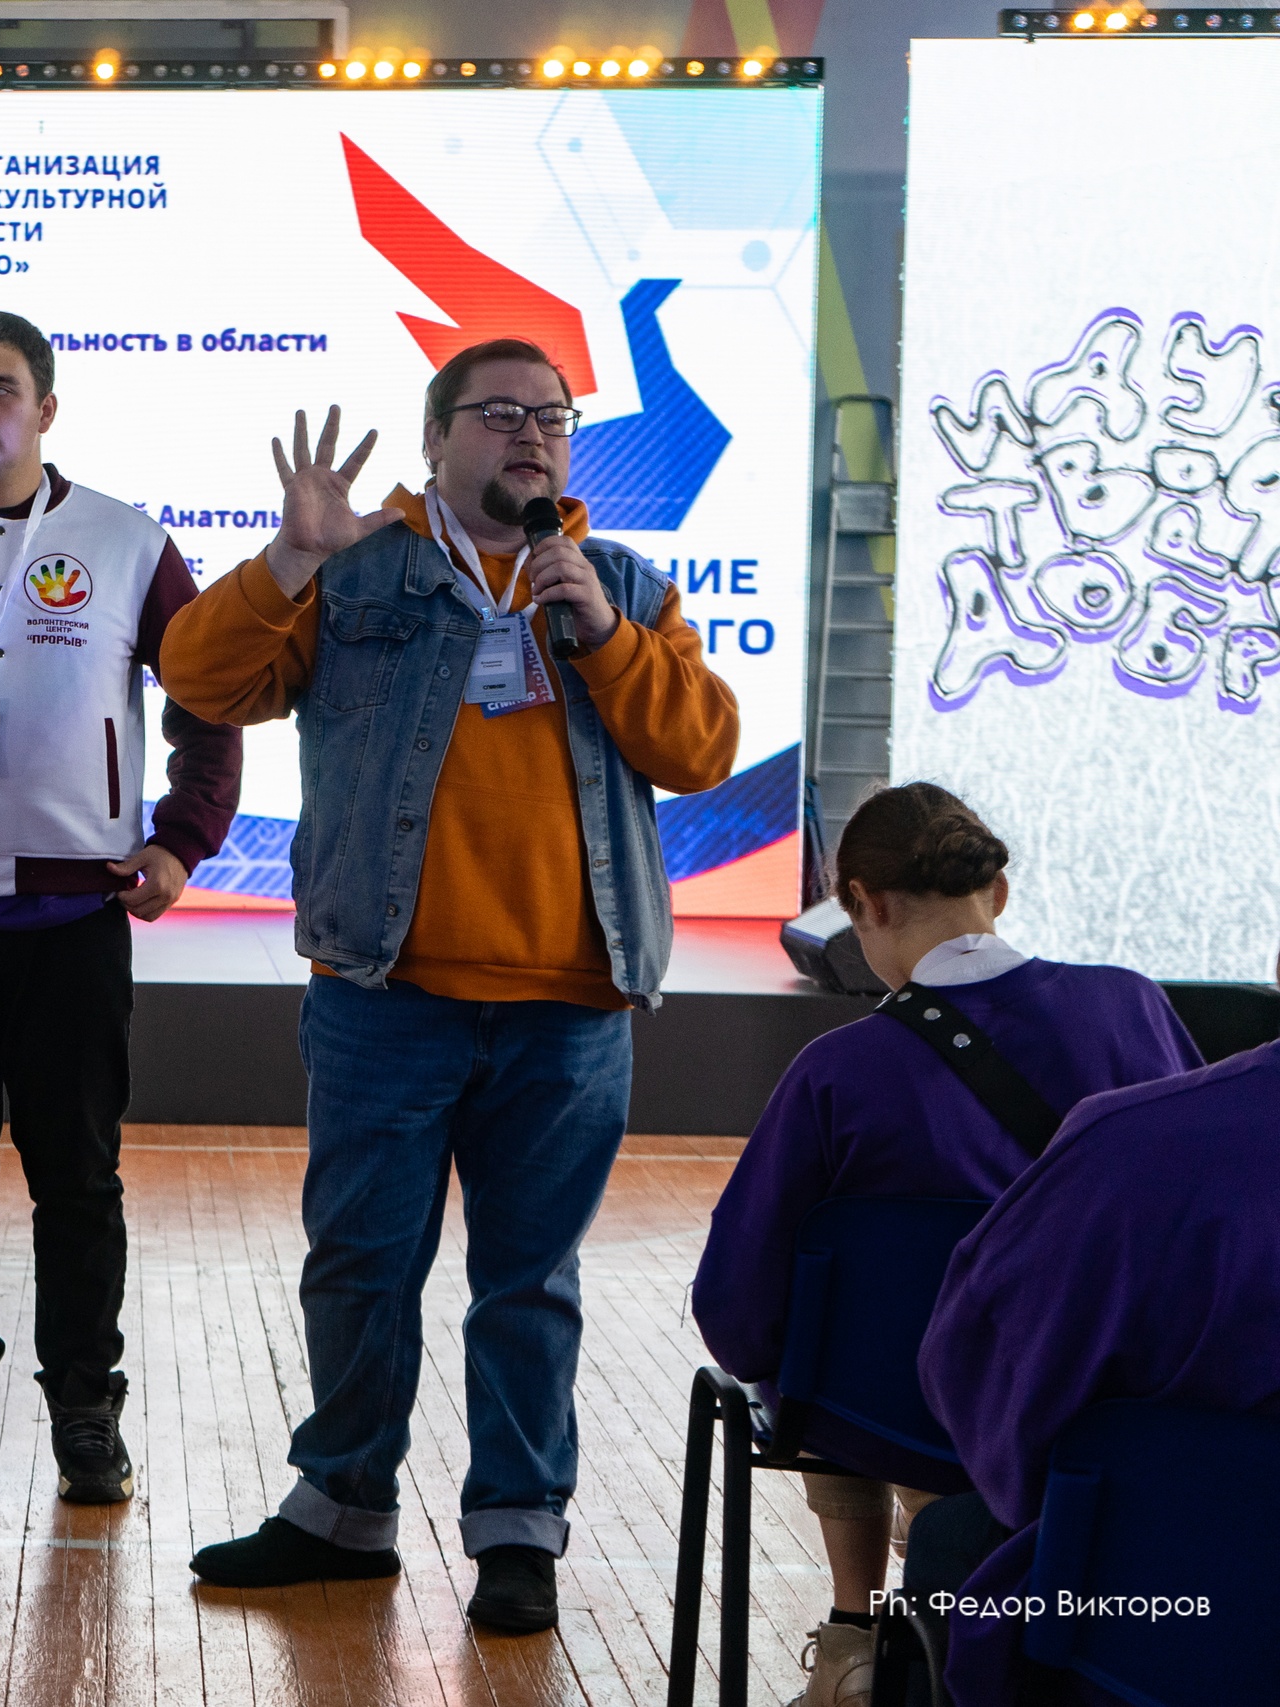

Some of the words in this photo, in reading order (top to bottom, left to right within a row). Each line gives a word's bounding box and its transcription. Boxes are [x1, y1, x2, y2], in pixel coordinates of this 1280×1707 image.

[49, 333, 168, 352] льность
[177, 333, 193, 352] в
[202, 328, 328, 352] области
[159, 504, 282, 528] Анатоль
[26, 618, 89, 630] ВОЛОНТЕРСКИЙ
[46, 625, 72, 633] ЦЕНТР
